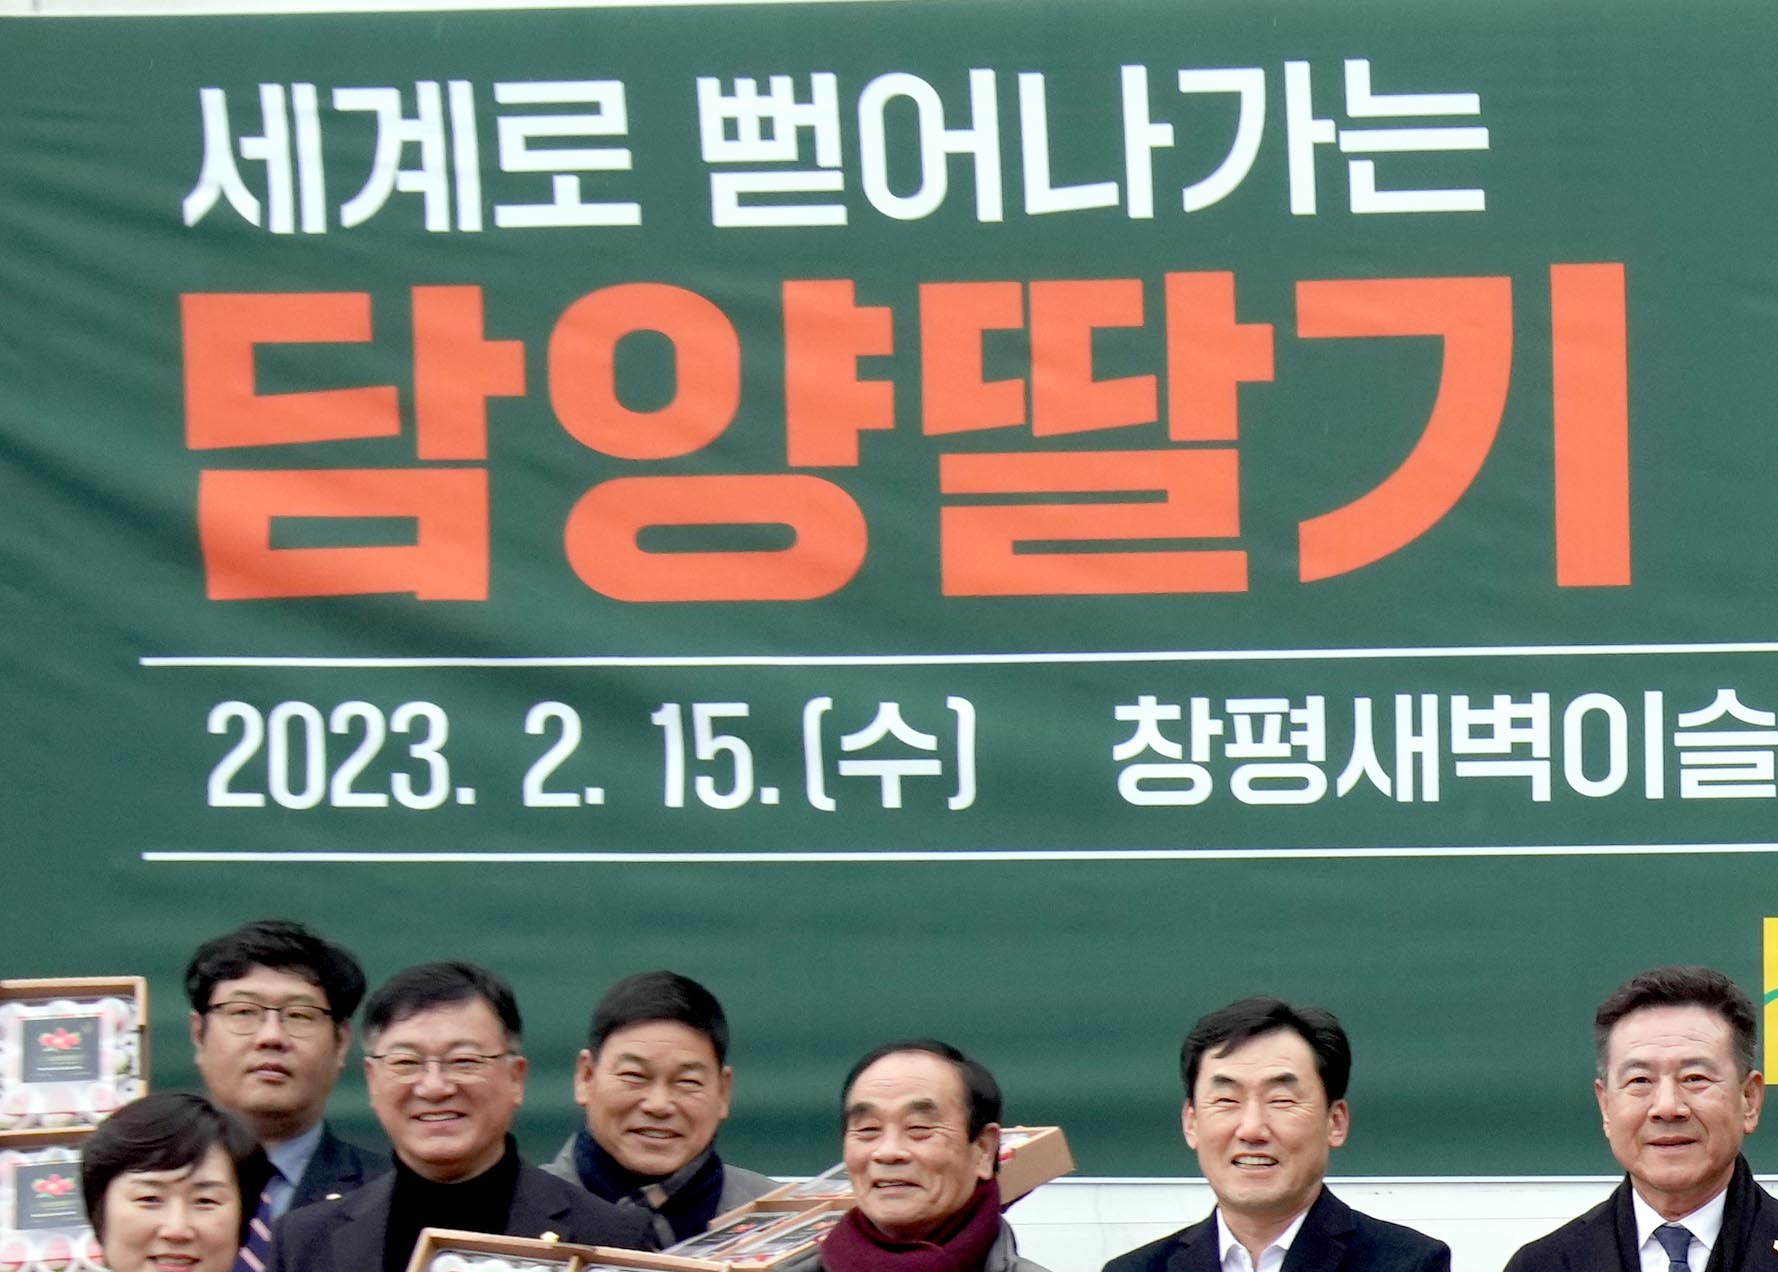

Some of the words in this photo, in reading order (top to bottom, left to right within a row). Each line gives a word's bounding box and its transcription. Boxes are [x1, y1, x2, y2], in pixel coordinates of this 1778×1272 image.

[183, 80, 641, 234] 세계로
[696, 59, 1489, 227] 뻗어나가는
[182, 264, 1630, 601] 담양딸기
[208, 701, 475, 809] 2023.
[523, 701, 604, 807] 2.
